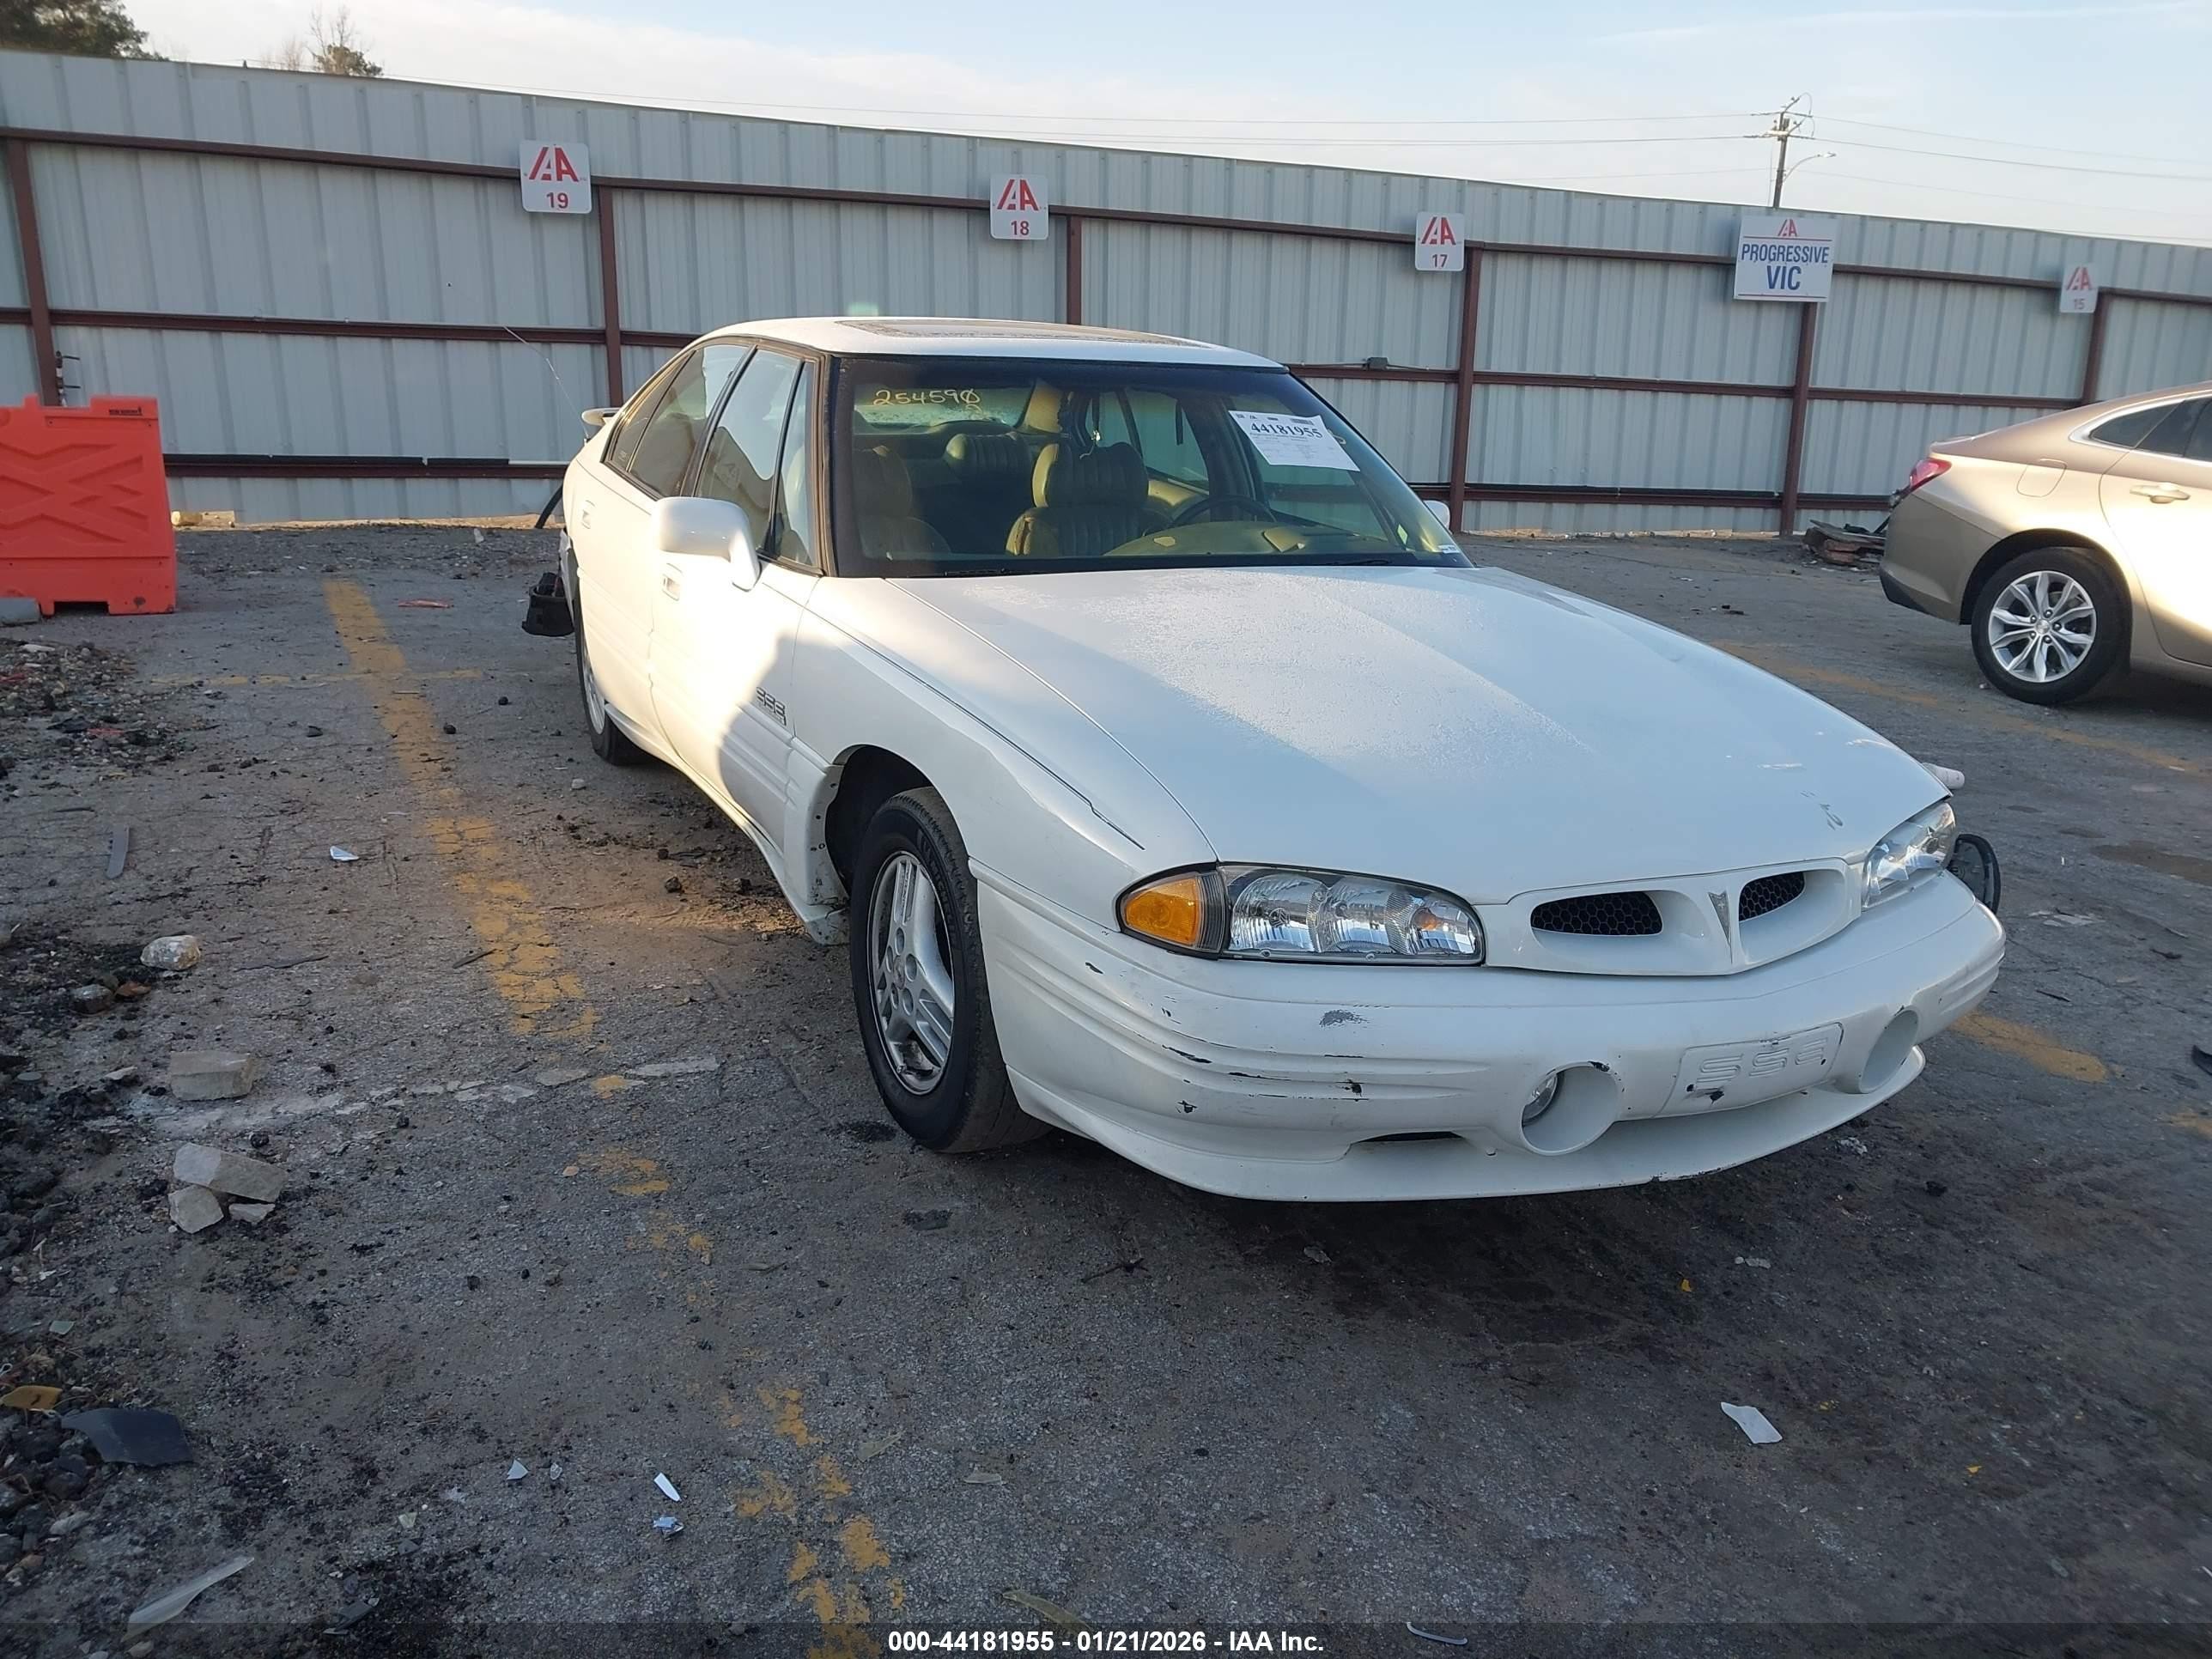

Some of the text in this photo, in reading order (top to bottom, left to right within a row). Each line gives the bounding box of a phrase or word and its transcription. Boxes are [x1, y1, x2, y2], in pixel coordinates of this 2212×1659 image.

[546, 191, 568, 209] 19
[1011, 220, 1030, 236] 18
[1431, 253, 1449, 268] 17
[1741, 243, 1830, 264] PROGRESSIVE
[1766, 265, 1802, 290] VIC
[1250, 422, 1332, 439] 44181955
